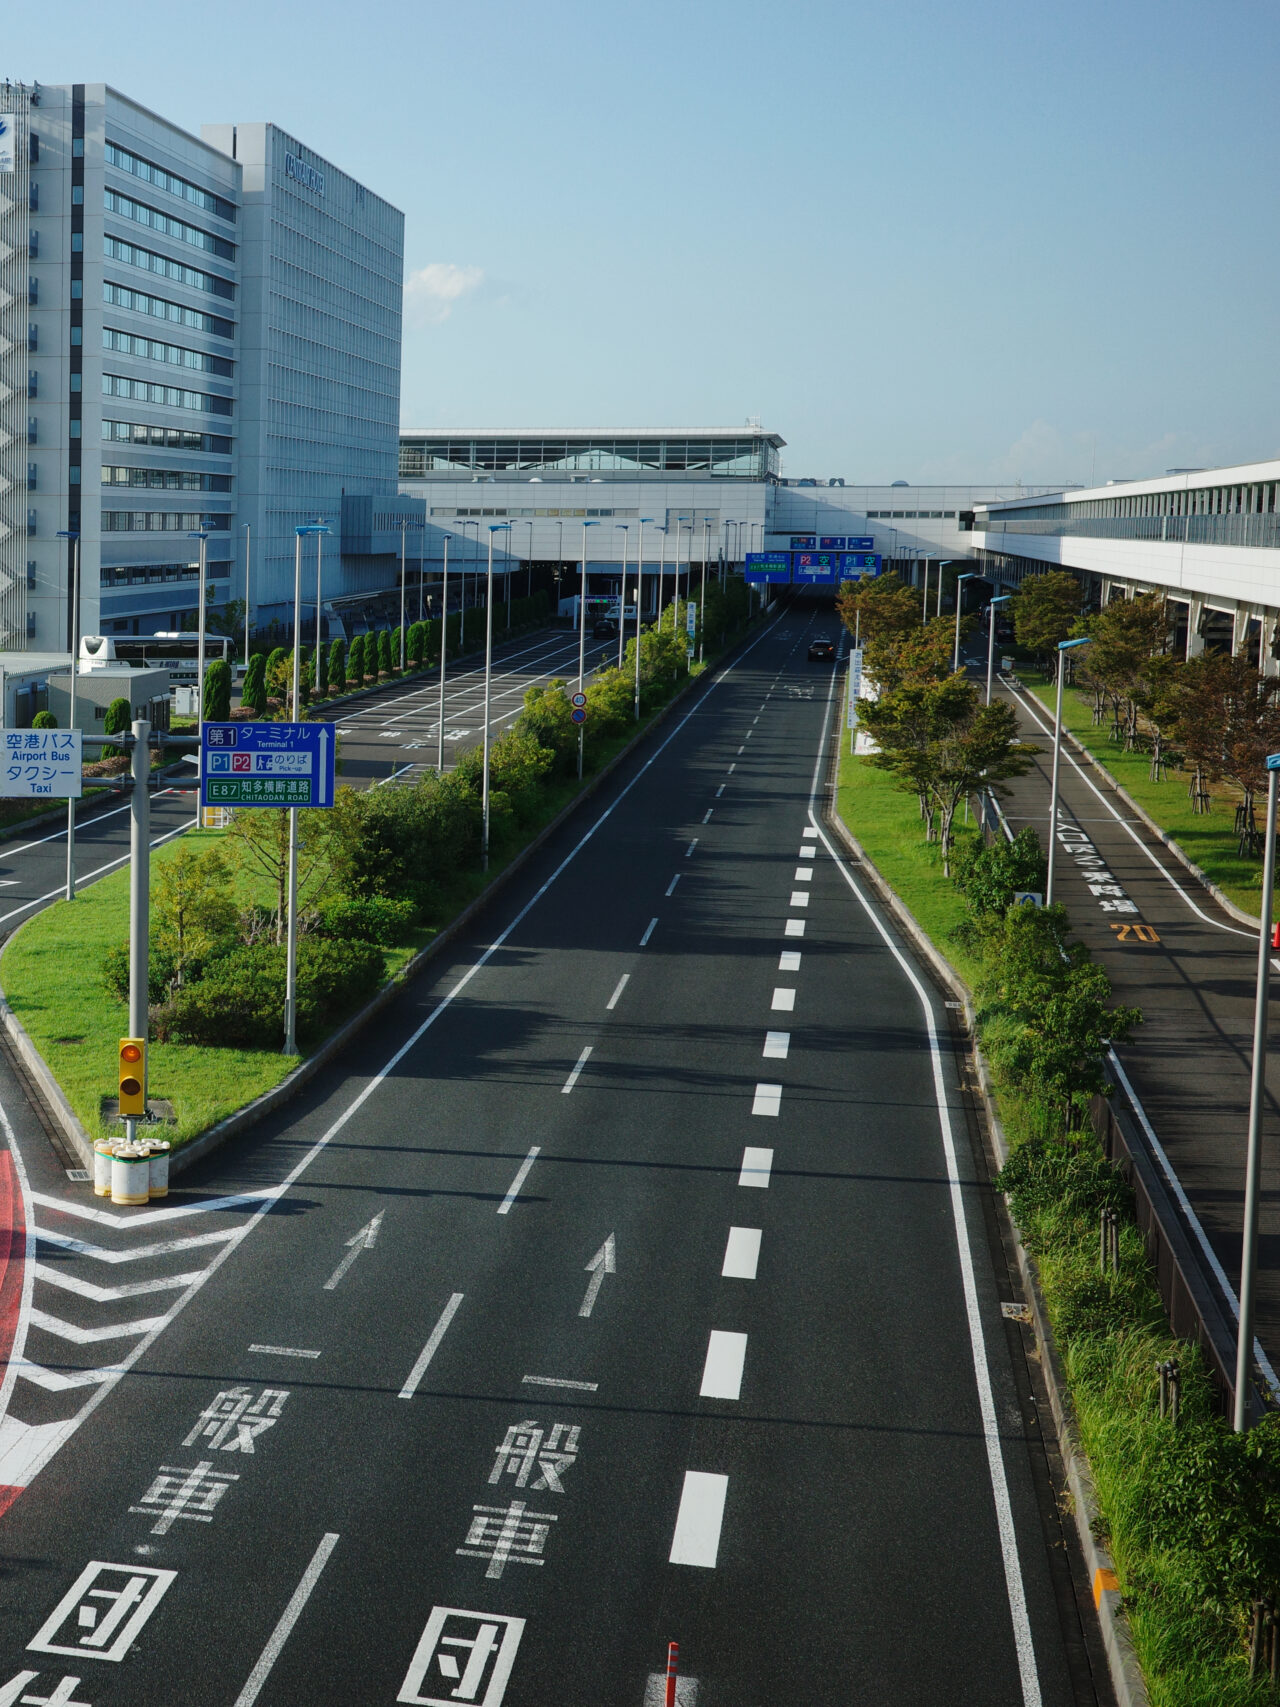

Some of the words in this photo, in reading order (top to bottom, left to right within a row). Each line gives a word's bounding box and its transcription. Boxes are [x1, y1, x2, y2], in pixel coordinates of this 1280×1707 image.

[6, 733, 75, 749] 空港バス
[209, 729, 234, 745] 第1
[241, 727, 311, 740] ターミナル
[257, 740, 288, 748] Terminal
[290, 740, 294, 748] 1
[11, 751, 47, 763] Airport
[51, 751, 70, 761] Bus
[212, 756, 228, 769] P1
[233, 756, 250, 769] P2
[274, 754, 308, 765] のりば
[6, 766, 74, 780] タクシー
[30, 783, 52, 793] Taxi
[212, 785, 237, 796] E87
[241, 780, 309, 794] 知多横断道路
[1109, 924, 1161, 943] 20
[396, 1605, 527, 1707] 団
